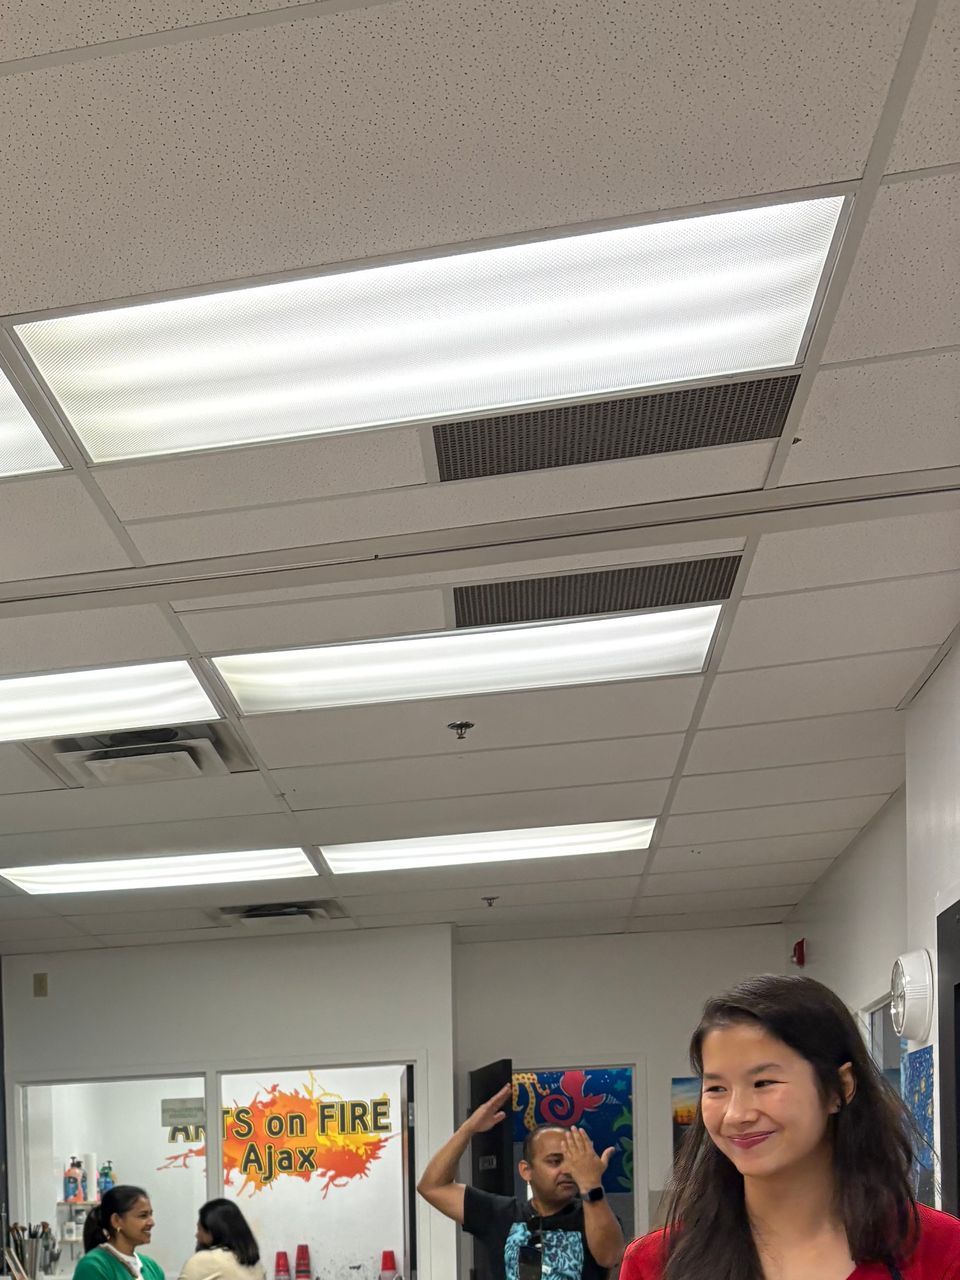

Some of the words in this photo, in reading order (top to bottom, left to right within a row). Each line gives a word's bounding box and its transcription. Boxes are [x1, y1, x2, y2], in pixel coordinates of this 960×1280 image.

[168, 1106, 255, 1143] ATS
[266, 1111, 307, 1138] on
[318, 1099, 391, 1136] FIRE
[241, 1142, 317, 1183] Ajax
